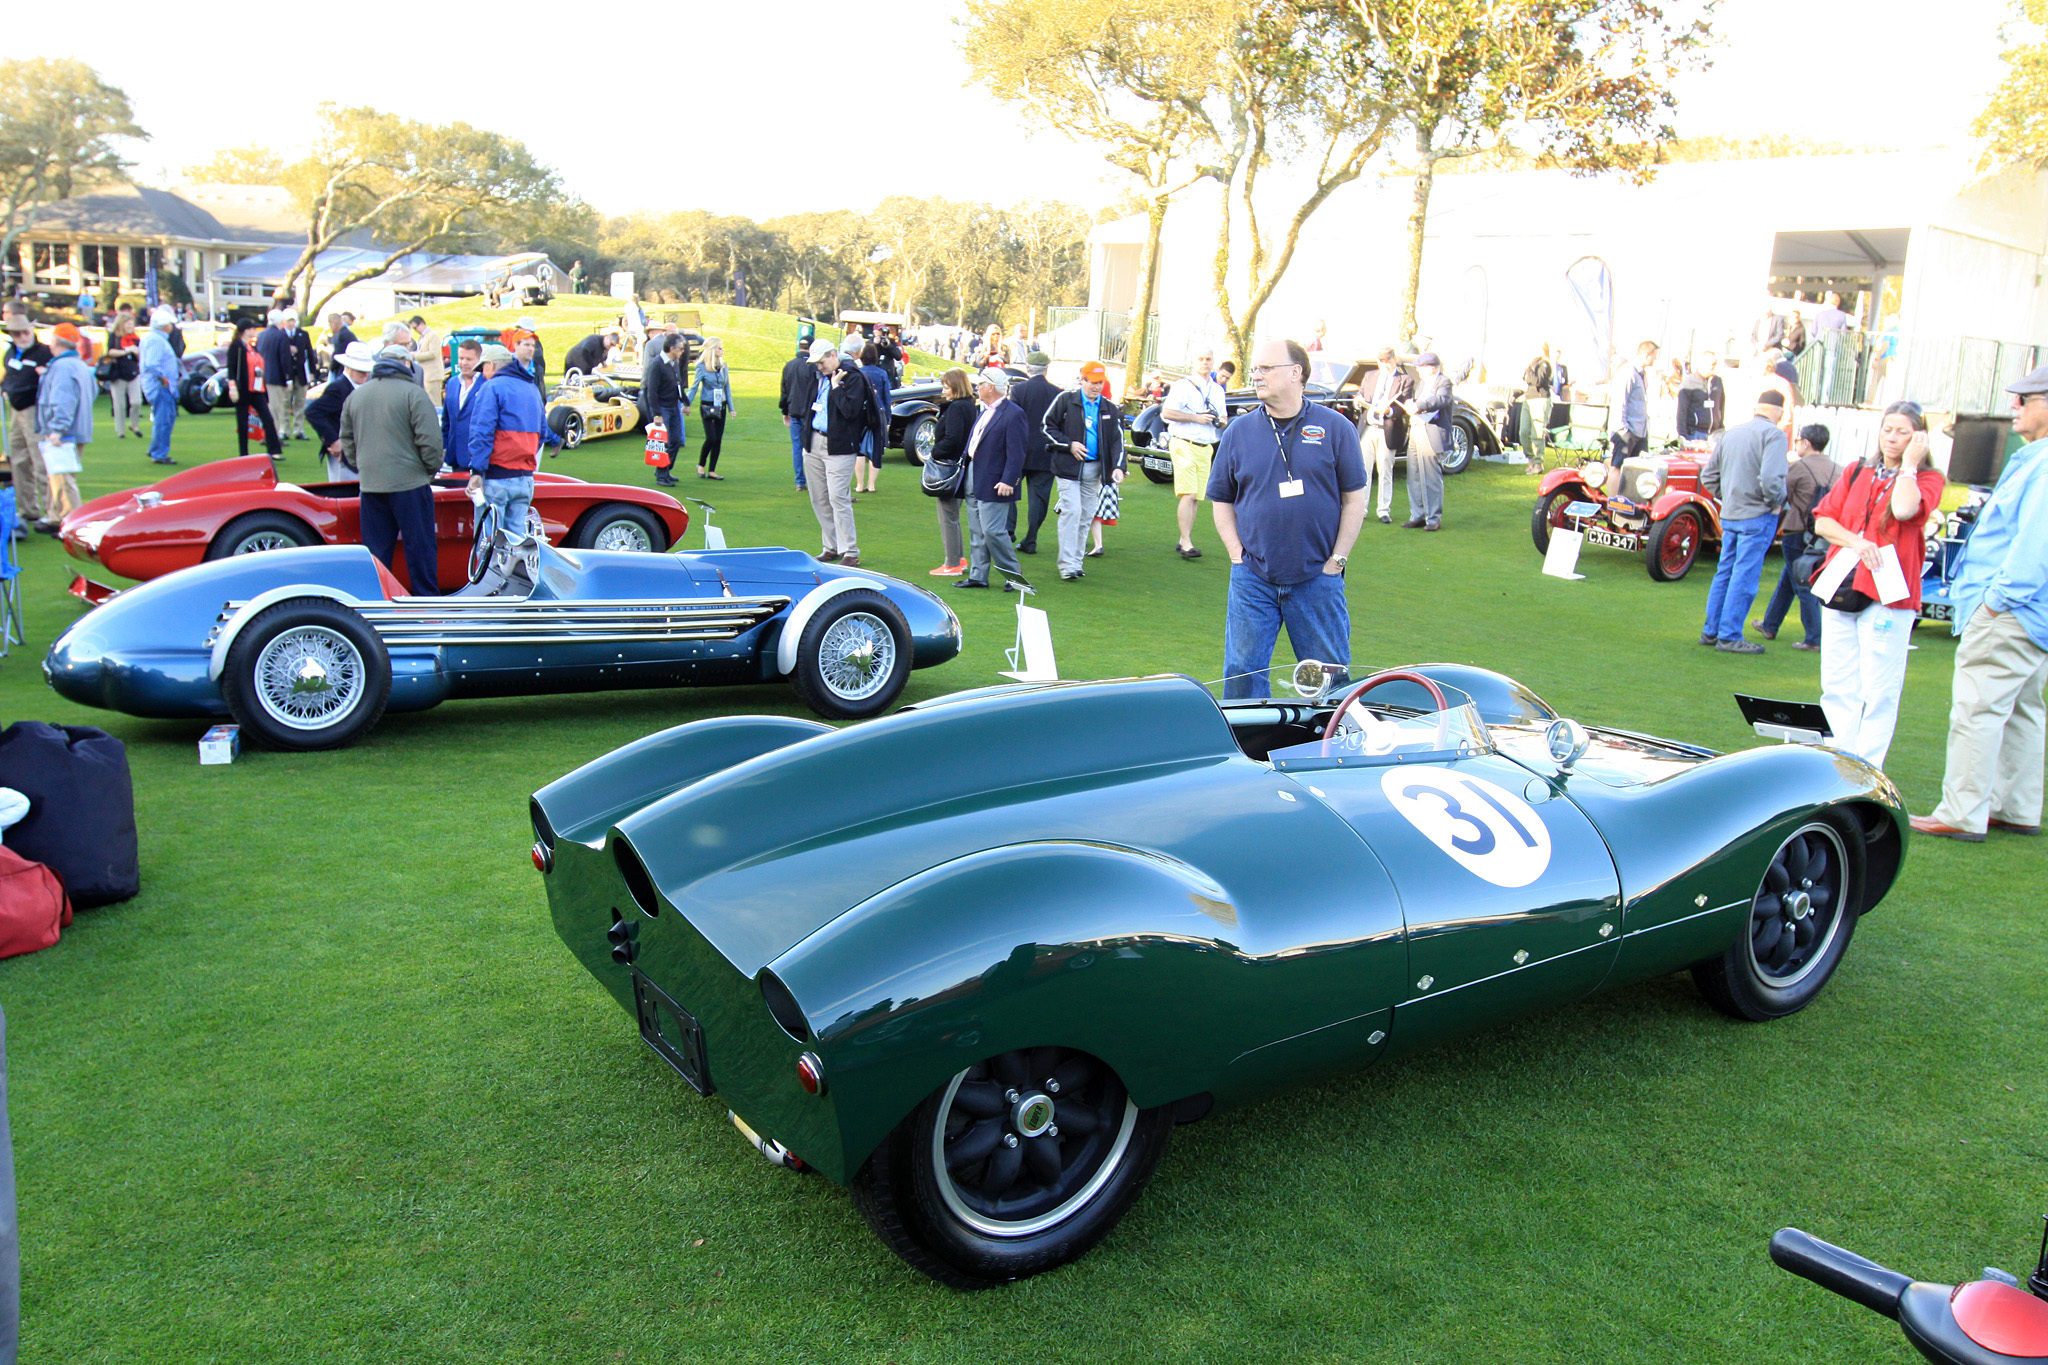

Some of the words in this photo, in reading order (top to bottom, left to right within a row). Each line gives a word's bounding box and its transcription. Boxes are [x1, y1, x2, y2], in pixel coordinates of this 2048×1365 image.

[603, 414, 614, 432] 12
[1589, 530, 1611, 545] CXO
[1612, 535, 1635, 549] 347
[1402, 780, 1539, 856] 31
